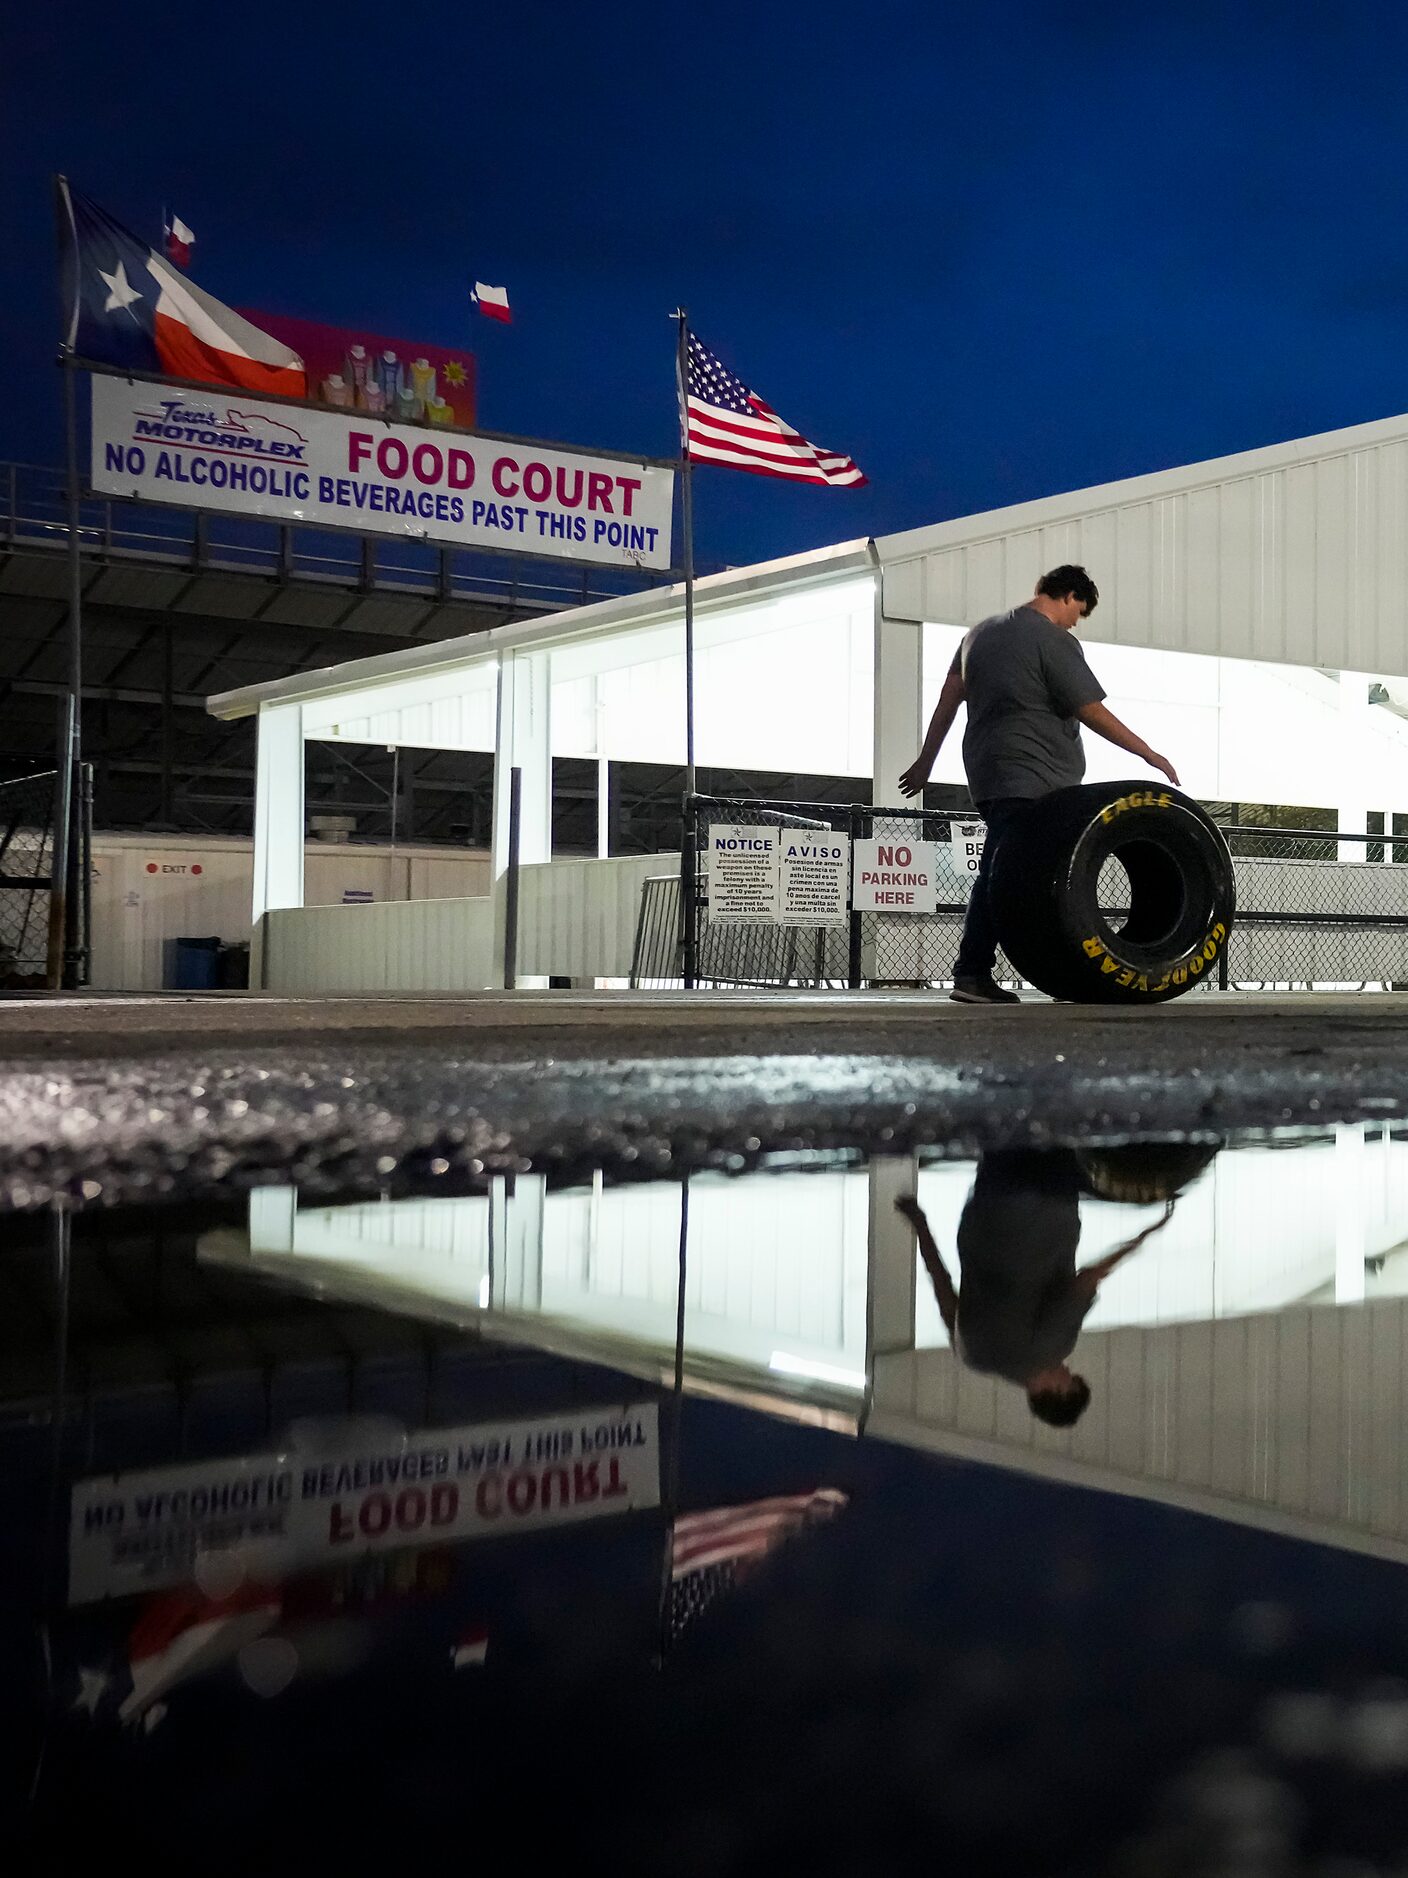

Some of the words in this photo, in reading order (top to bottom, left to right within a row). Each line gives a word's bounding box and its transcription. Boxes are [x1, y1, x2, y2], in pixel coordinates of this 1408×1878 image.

[135, 420, 305, 459] MOTORPLEX
[349, 431, 476, 490] FOOD
[492, 457, 641, 516] COURT
[105, 442, 145, 475] NO
[155, 451, 310, 500] ALCOHOLIC
[319, 476, 464, 523] BEVERAGES
[472, 500, 528, 533] PAST
[536, 510, 586, 542] THIS
[594, 519, 659, 552] POINT
[1102, 791, 1173, 825] EAGLE
[715, 839, 772, 850] NOTICE
[787, 846, 841, 858] AVISO
[878, 846, 912, 867] NO
[162, 865, 187, 873] EXIT
[862, 872, 928, 886] PARKING
[875, 892, 915, 904] HERE
[1082, 922, 1226, 992] GOODYEAR
